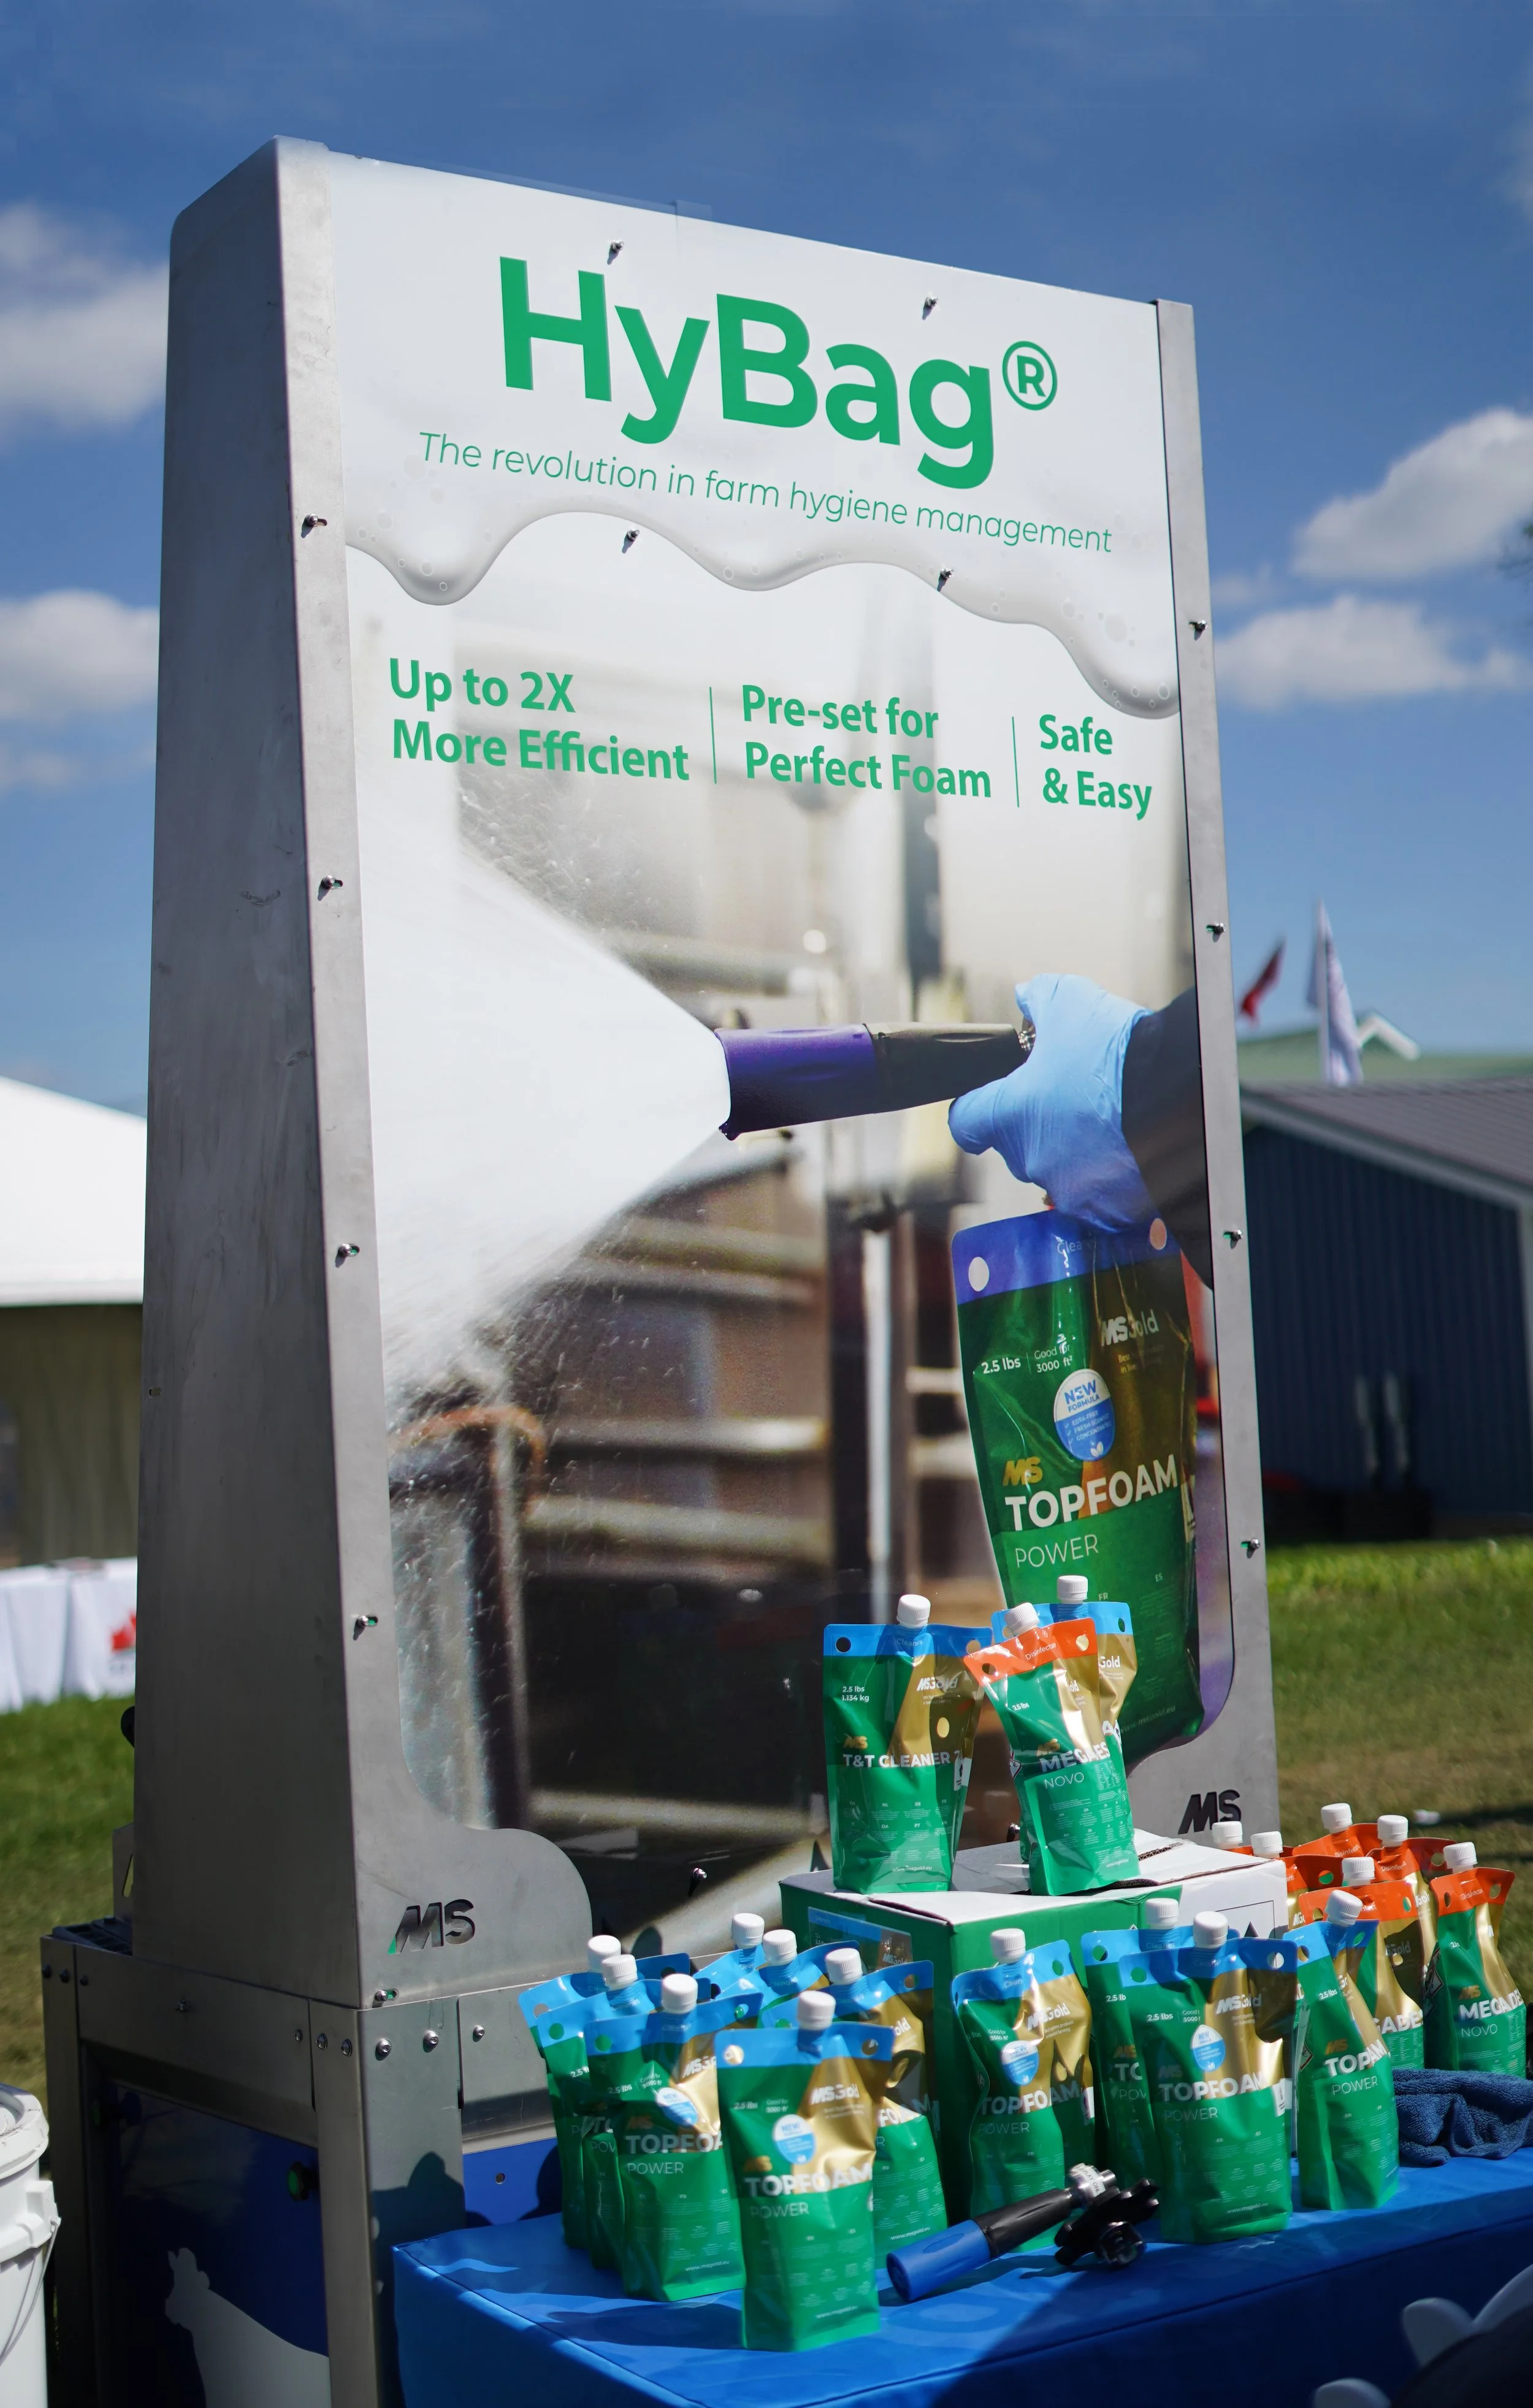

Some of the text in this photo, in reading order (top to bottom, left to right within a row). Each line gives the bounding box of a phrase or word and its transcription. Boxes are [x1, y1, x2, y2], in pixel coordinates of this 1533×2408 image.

[419, 431, 1112, 553] The revolution in farm hygiene management
[390, 658, 576, 713] Up to 2X
[742, 684, 939, 738] Pre-set for
[1039, 714, 1113, 755] Safe
[393, 719, 690, 781] More Efficient
[746, 742, 992, 798] Perfect Foam
[1042, 767, 1152, 821] & Easy
[1034, 1348, 1058, 1360] Good
[981, 1356, 1022, 1375] 2.5 lbs
[1036, 1360, 1060, 1373] 3000
[1064, 1379, 1097, 1405] NEW
[1068, 1395, 1101, 1413] FORMULA
[1003, 1455, 1043, 1486] MS
[1004, 1454, 1179, 1532] TOPFOAM
[1015, 1533, 1099, 1568] POWER
[843, 1754, 875, 1768] T&T
[878, 1751, 951, 1768] CLEANER
[1044, 1771, 1085, 1790] NOVO
[1178, 1789, 1242, 1835] MS
[387, 1899, 476, 1955] MS
[1106, 1994, 1118, 2003] 2.5
[1328, 1988, 1338, 1997] lbs
[1161, 2012, 1174, 2021] lbs
[1461, 2023, 1498, 2038] NOVO
[608, 2084, 633, 2095] 2.5 lbs
[1332, 2076, 1378, 2096] POWER
[982, 2080, 1082, 2115] TOPFOAM
[1164, 2106, 1219, 2121] POWER
[977, 2122, 1031, 2135] POWER
[625, 2129, 724, 2155] TOPFOA
[628, 2161, 684, 2174] POWER
[744, 2161, 873, 2198] TOPFOAM
[749, 2201, 811, 2219] POWER
[890, 2226, 931, 2241] www.msgold.eu
